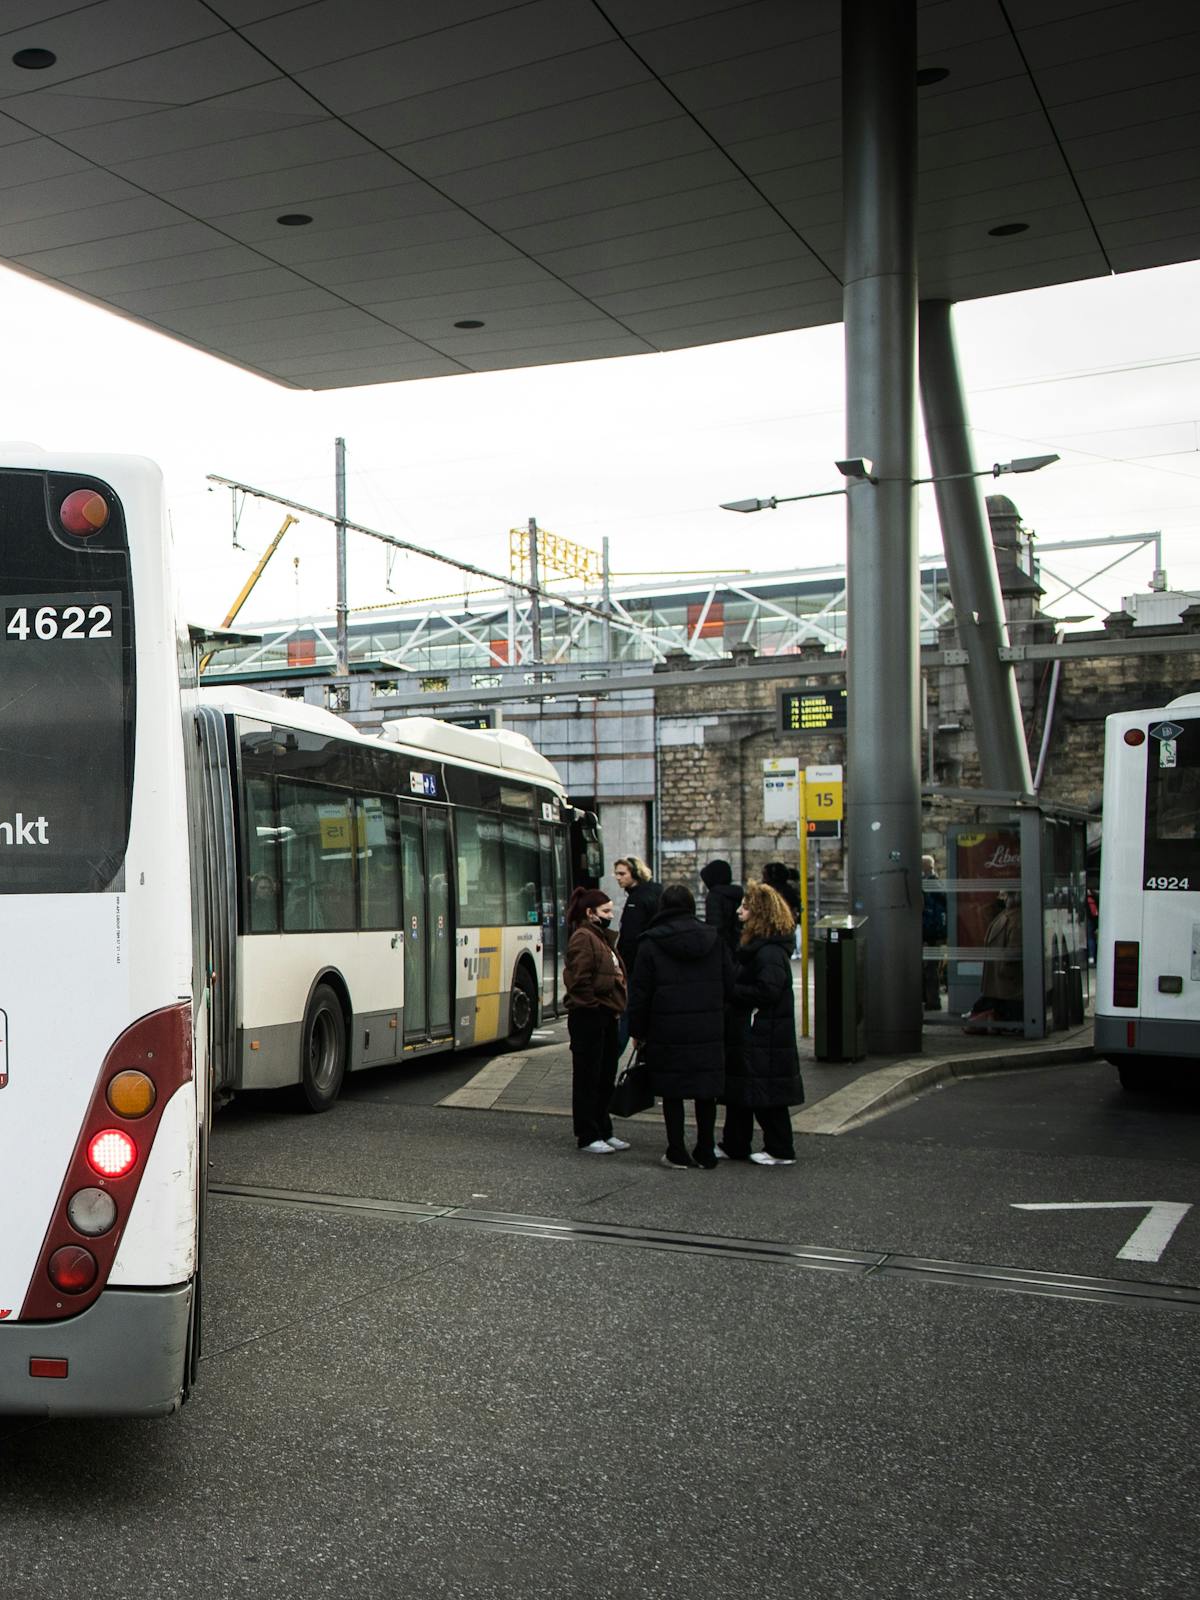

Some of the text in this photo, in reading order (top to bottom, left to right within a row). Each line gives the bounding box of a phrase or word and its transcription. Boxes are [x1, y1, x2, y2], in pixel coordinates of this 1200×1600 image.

[6, 606, 112, 640] 4622
[815, 792, 834, 807] 15
[1147, 877, 1189, 889] 4924
